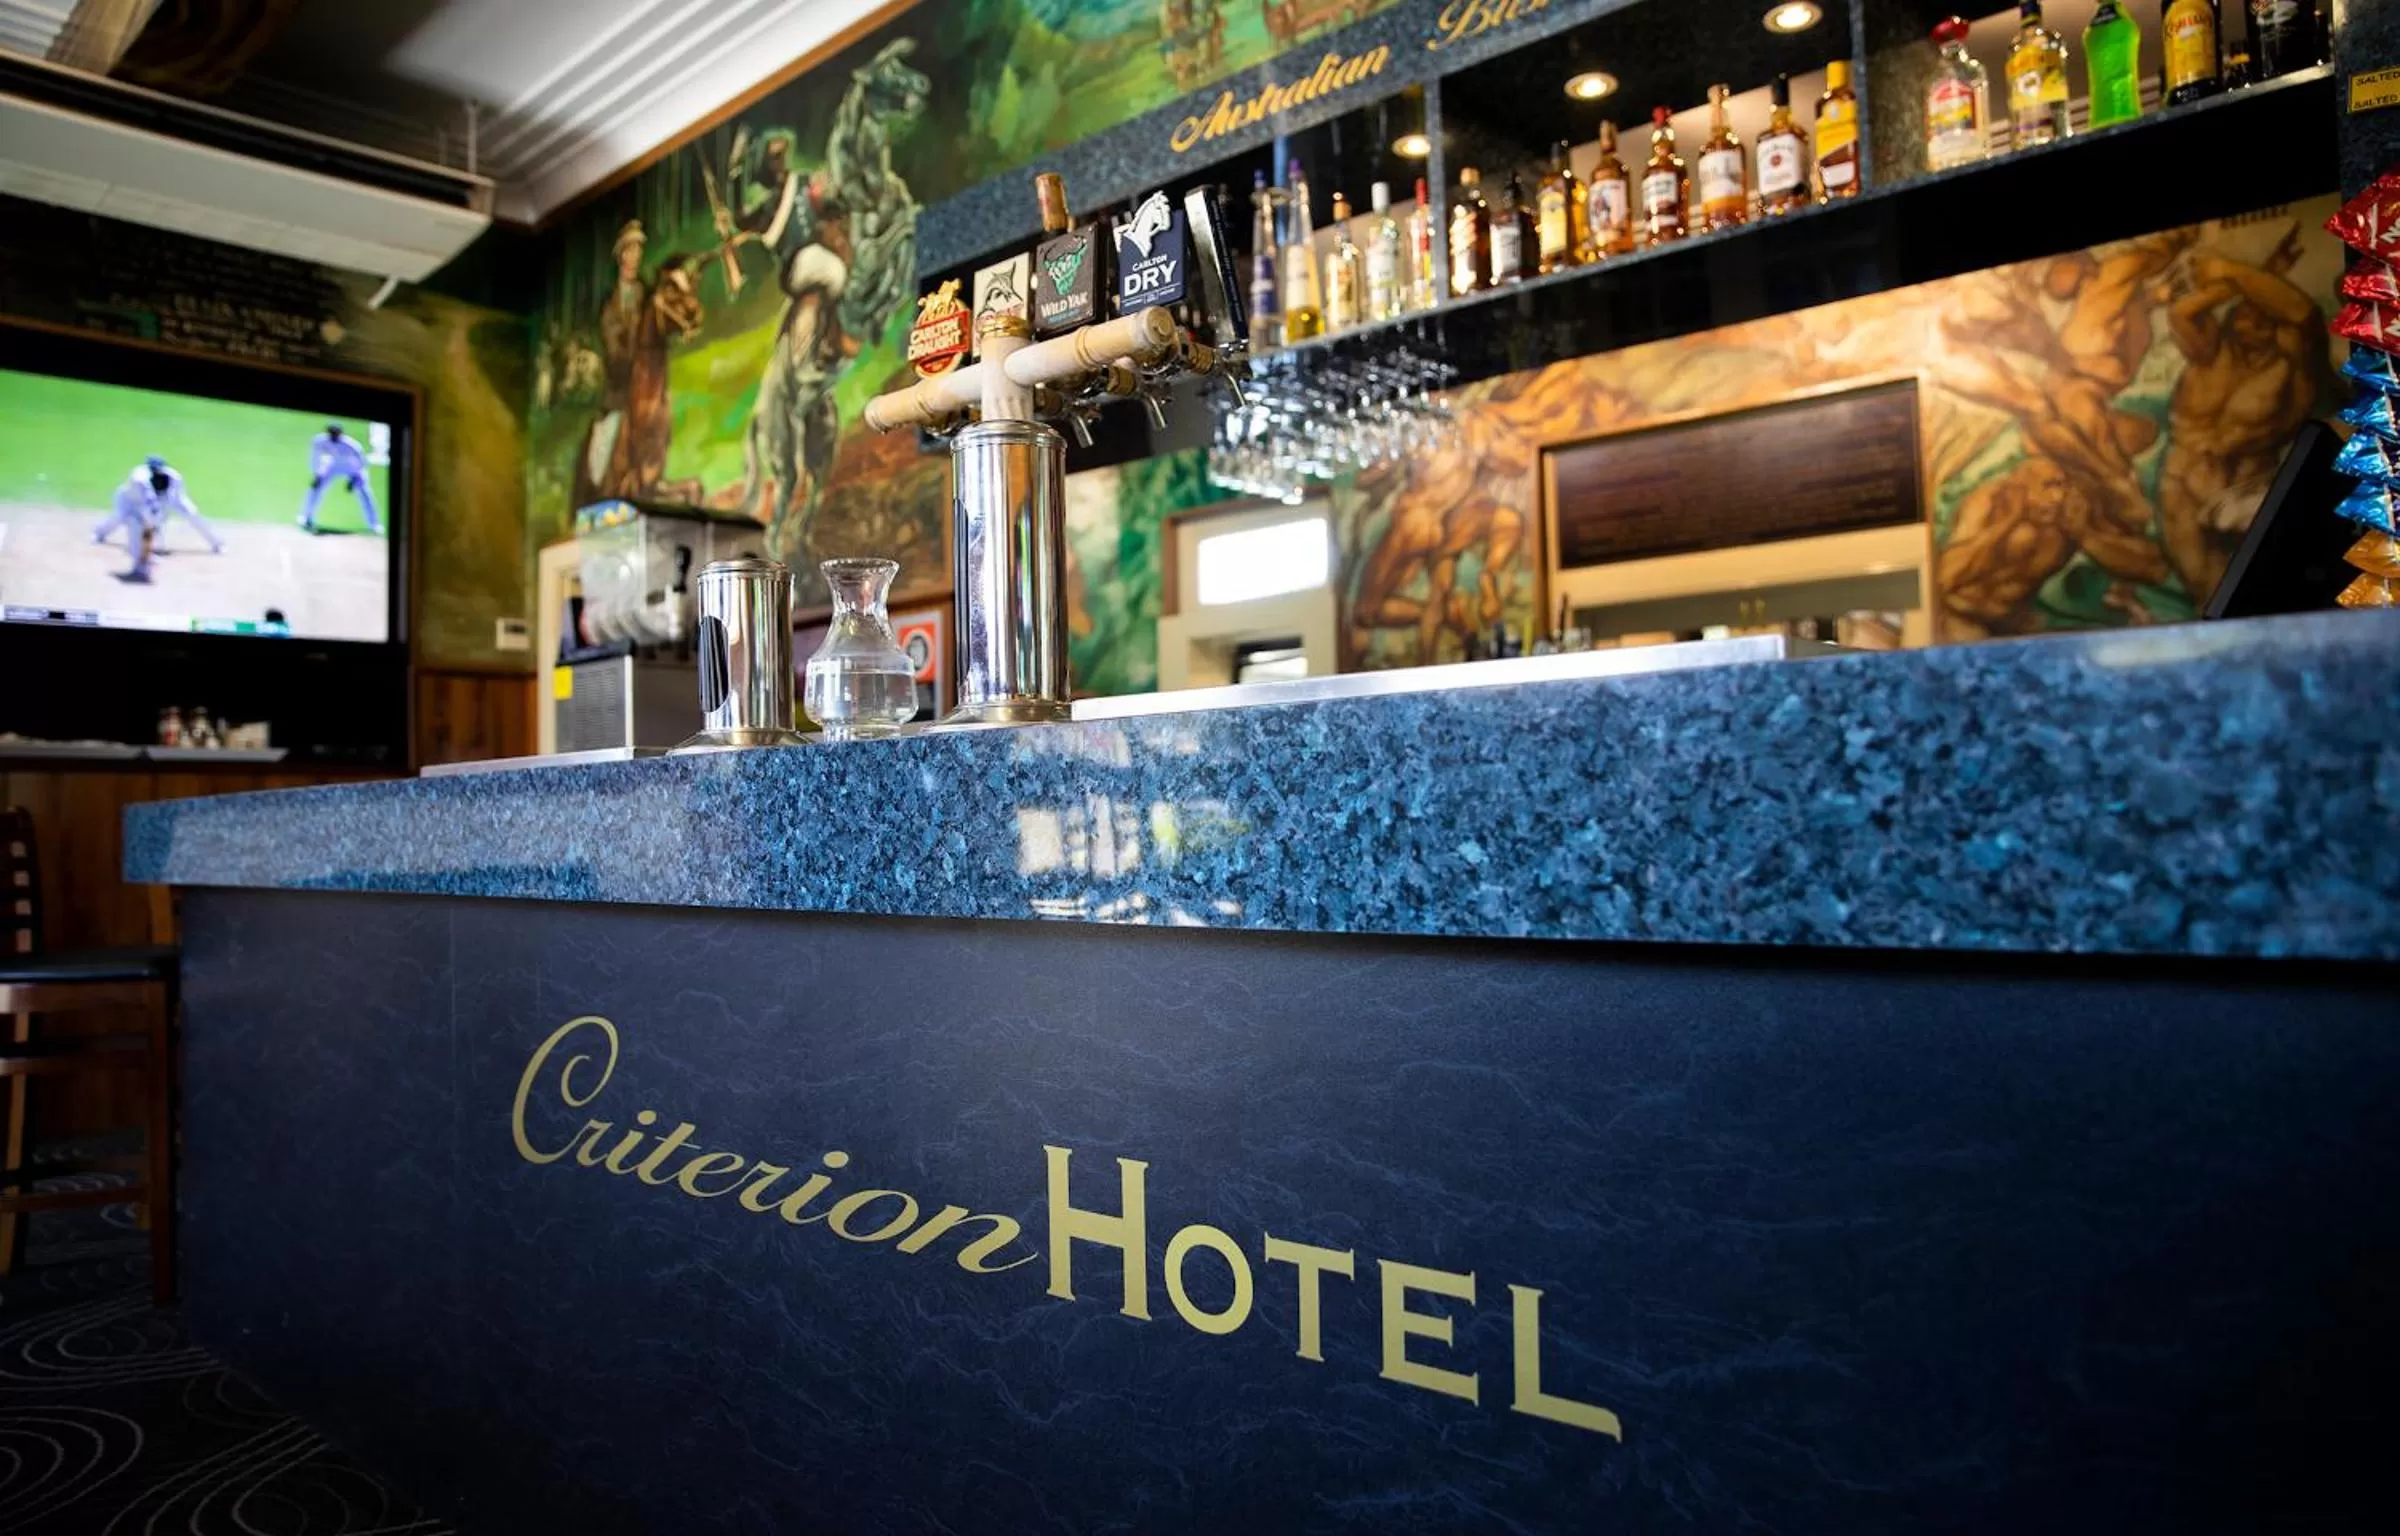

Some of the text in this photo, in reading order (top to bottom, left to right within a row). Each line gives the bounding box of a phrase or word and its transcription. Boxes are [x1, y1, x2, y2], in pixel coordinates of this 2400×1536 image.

[1169, 45, 1390, 153] Australian
[1123, 260, 1177, 297] DRY
[1131, 253, 1168, 273] CARLTON
[1041, 299, 1068, 318] WILD
[1066, 290, 1089, 309] YAK
[910, 314, 961, 345] CARLTON
[511, 1014, 1622, 1444] Criterion HOTEL
